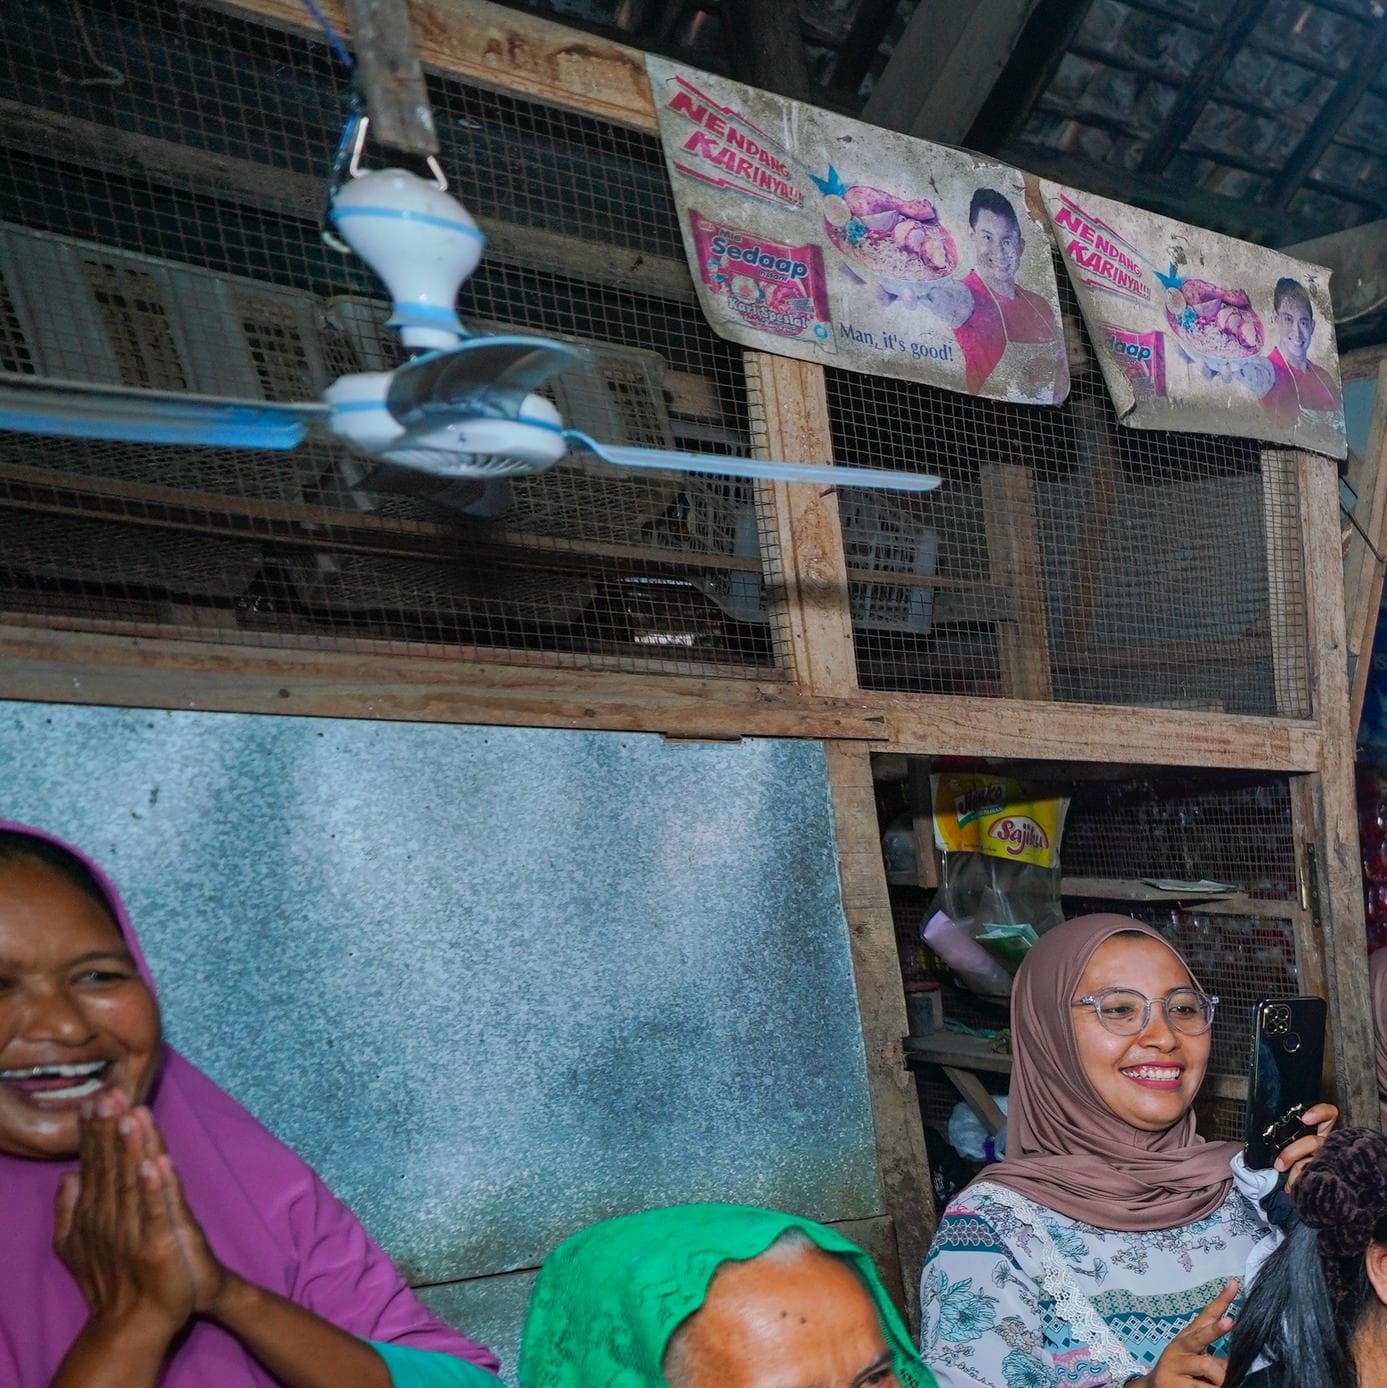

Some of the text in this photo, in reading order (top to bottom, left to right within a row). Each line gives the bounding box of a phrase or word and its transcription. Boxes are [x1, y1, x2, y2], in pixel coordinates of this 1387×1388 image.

[668, 91, 790, 178] NENDANG
[684, 130, 803, 204] KARINYA!!!
[711, 236, 808, 279] Sedaap
[719, 229, 741, 241] Mie
[1055, 207, 1142, 277] NENDANG
[1066, 240, 1151, 298] KARINYA!!!
[728, 296, 757, 315] Kari
[840, 323, 953, 363] Man, it's good!
